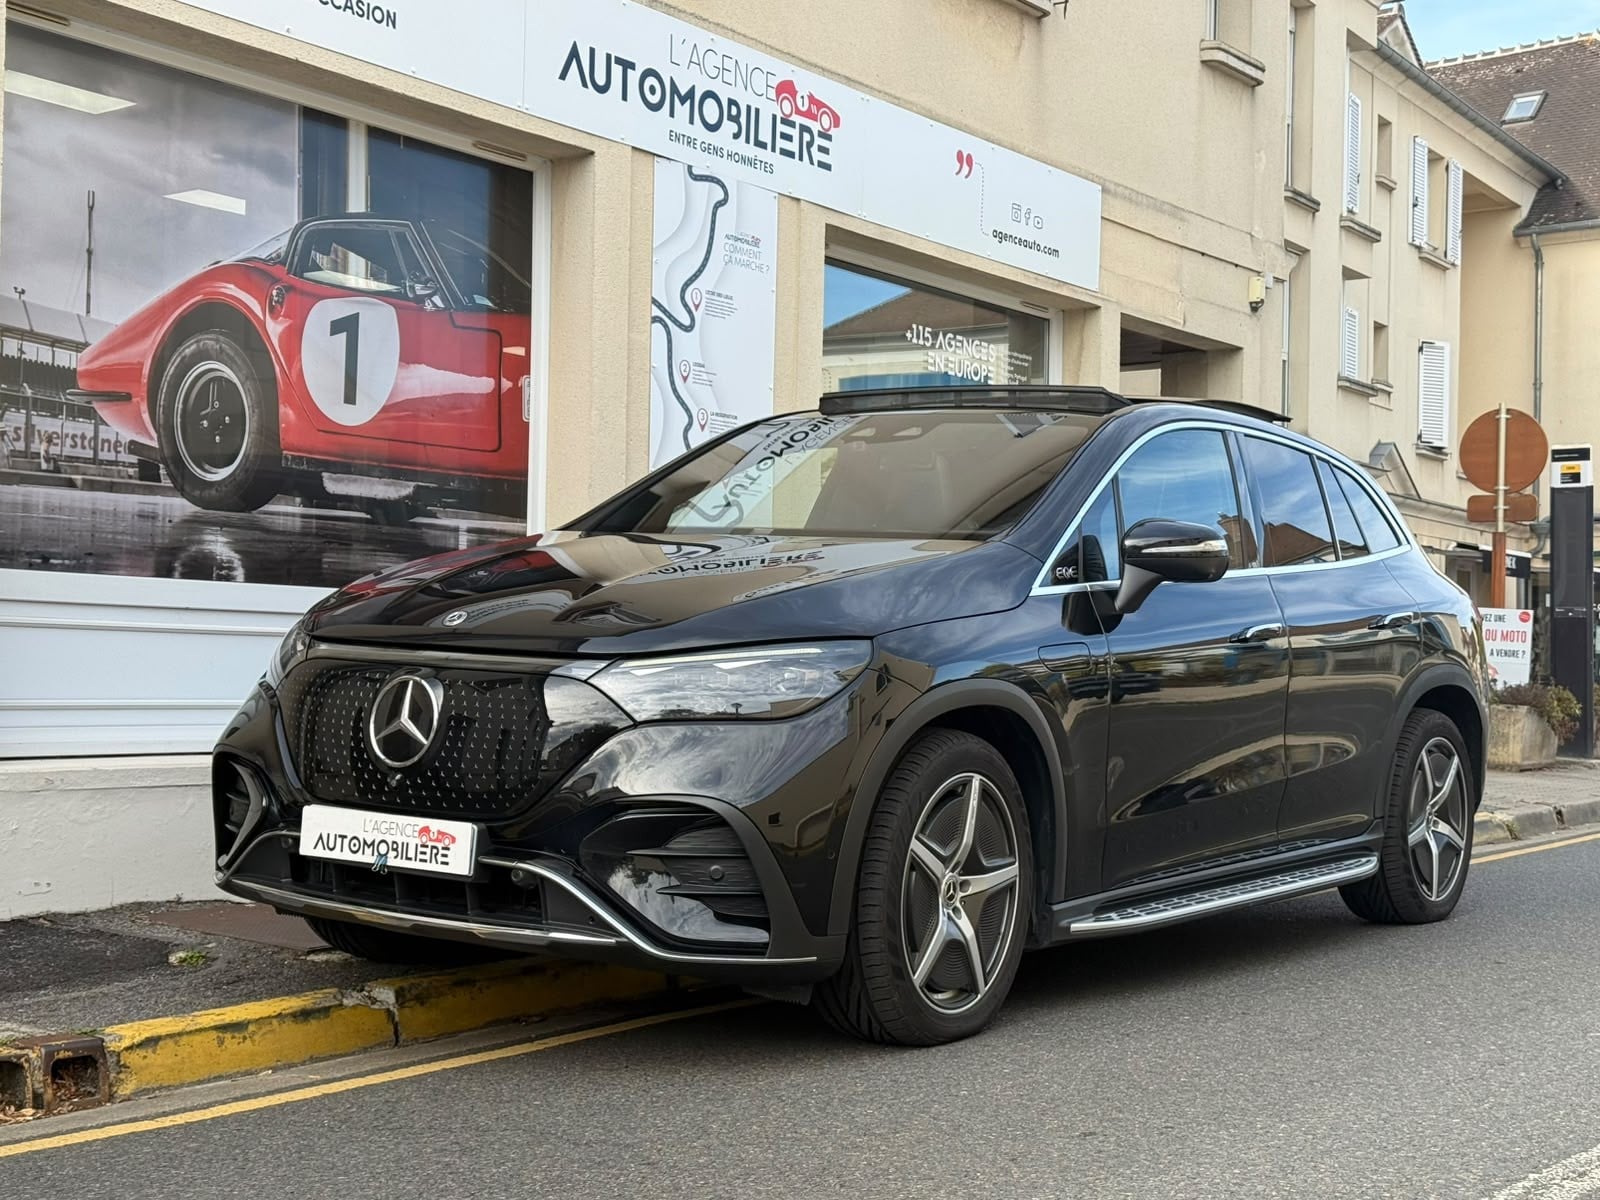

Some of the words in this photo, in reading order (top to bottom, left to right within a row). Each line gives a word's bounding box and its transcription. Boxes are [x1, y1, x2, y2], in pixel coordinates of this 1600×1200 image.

[319, 0, 397, 29] CASION
[669, 33, 777, 102] L'AGENCE
[669, 129, 698, 151] ENTRE
[700, 140, 724, 159] GENS
[726, 147, 774, 175] HONNÊTES
[723, 242, 762, 261] COMMENT
[992, 229, 1060, 258] agenceauto.com
[735, 257, 764, 273] MARCHE
[905, 323, 932, 347] +115
[935, 331, 996, 362] AGENCES
[330, 311, 360, 406] 1
[927, 351, 945, 373] EN
[948, 355, 995, 385] EUROPE
[1055, 565, 1078, 580] EQE
[1493, 613, 1507, 623] UNE
[1485, 628, 1497, 642] OU
[1500, 630, 1527, 644] MOTO
[1489, 648, 1495, 657] A
[1496, 648, 1520, 659] VENDRE
[363, 818, 419, 839] L'AGENCE
